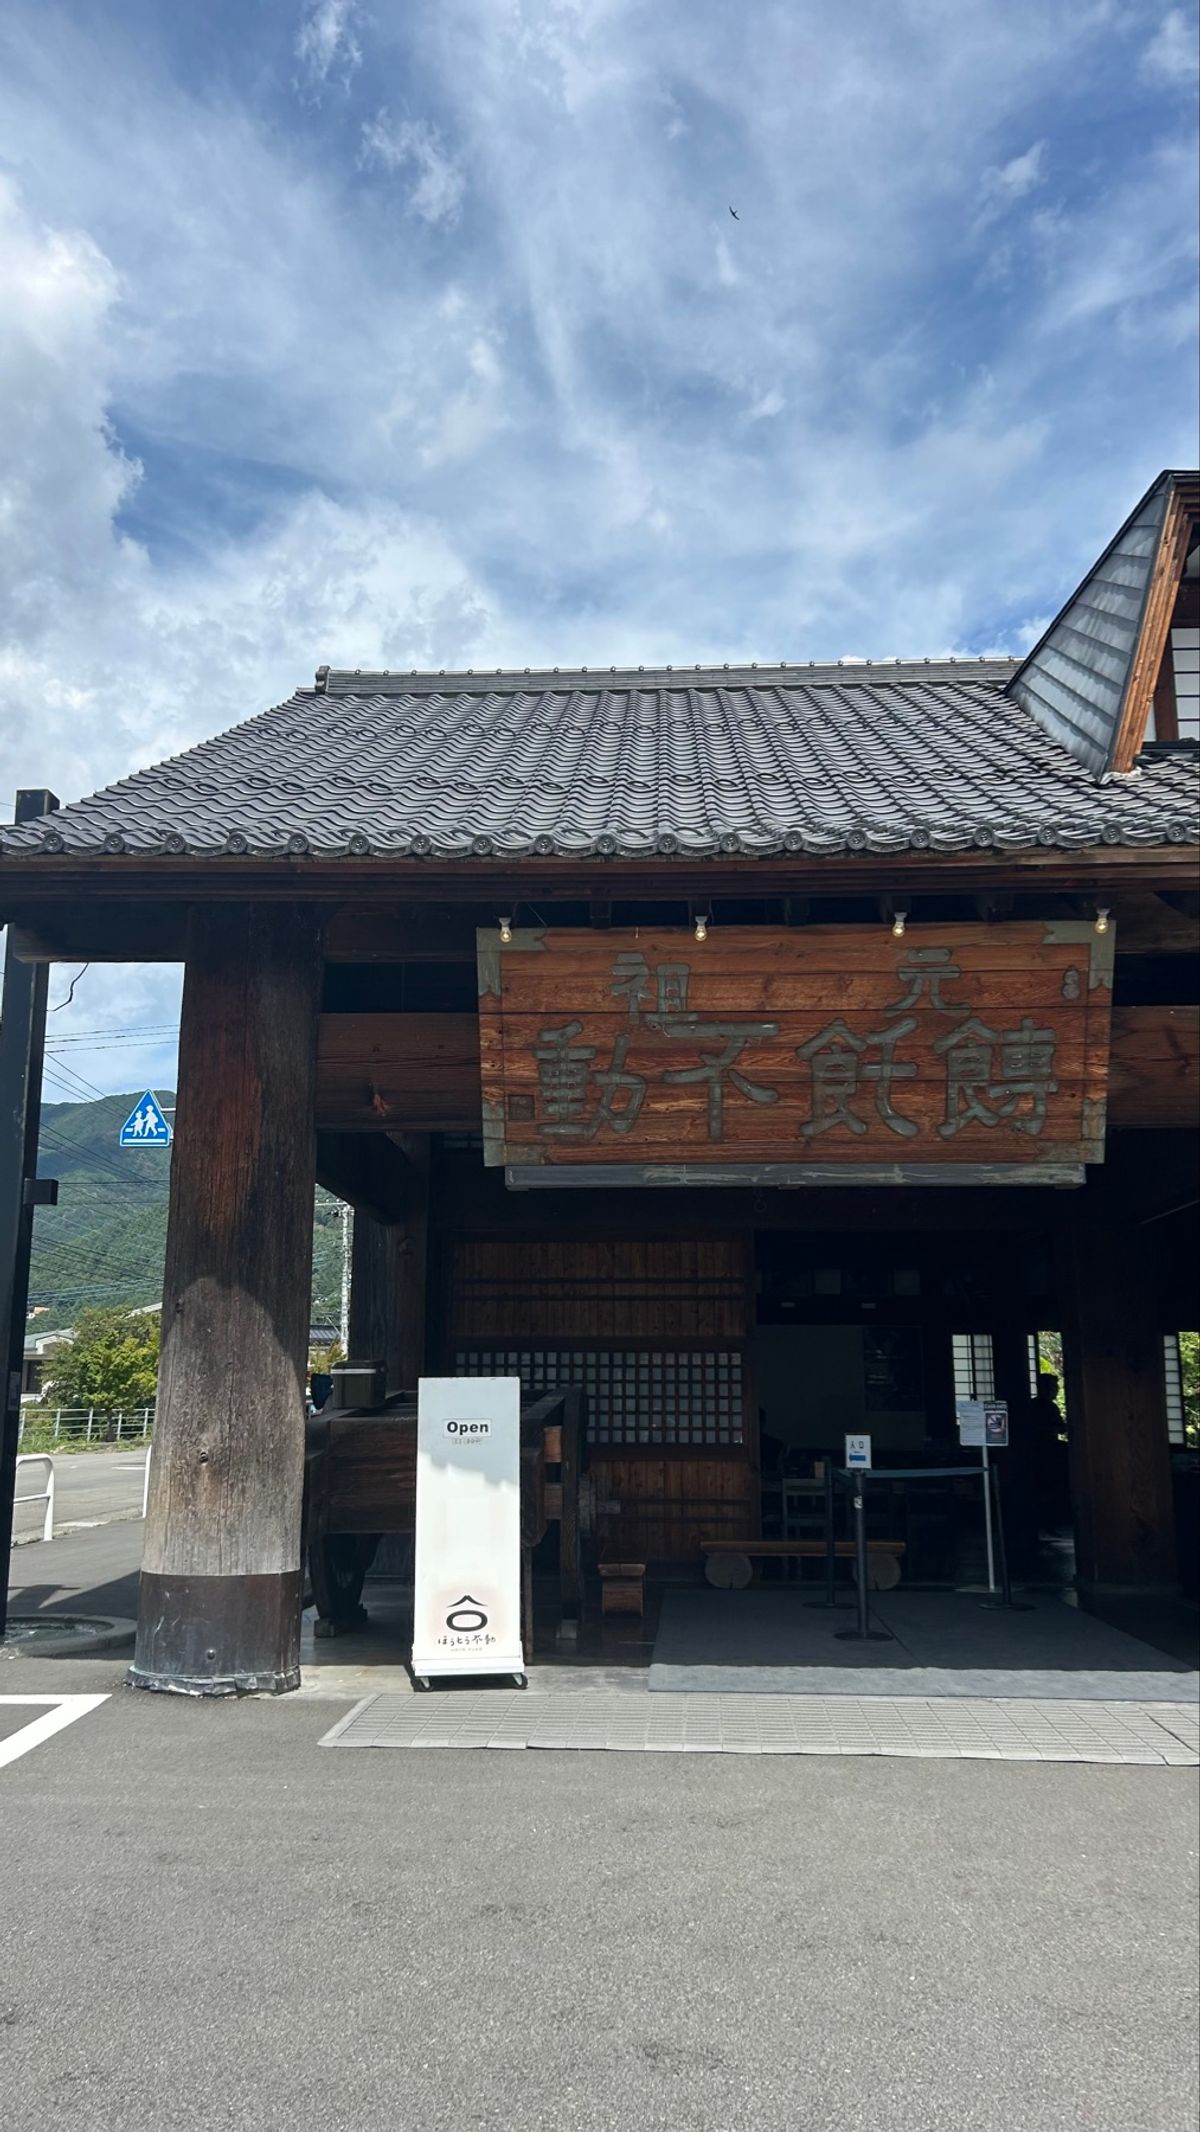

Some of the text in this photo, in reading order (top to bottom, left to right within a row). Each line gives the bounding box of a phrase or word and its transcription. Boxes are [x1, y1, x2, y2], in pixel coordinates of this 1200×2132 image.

[446, 1421, 489, 1436] Open
[437, 1634, 496, 1646] ほうとう不動
